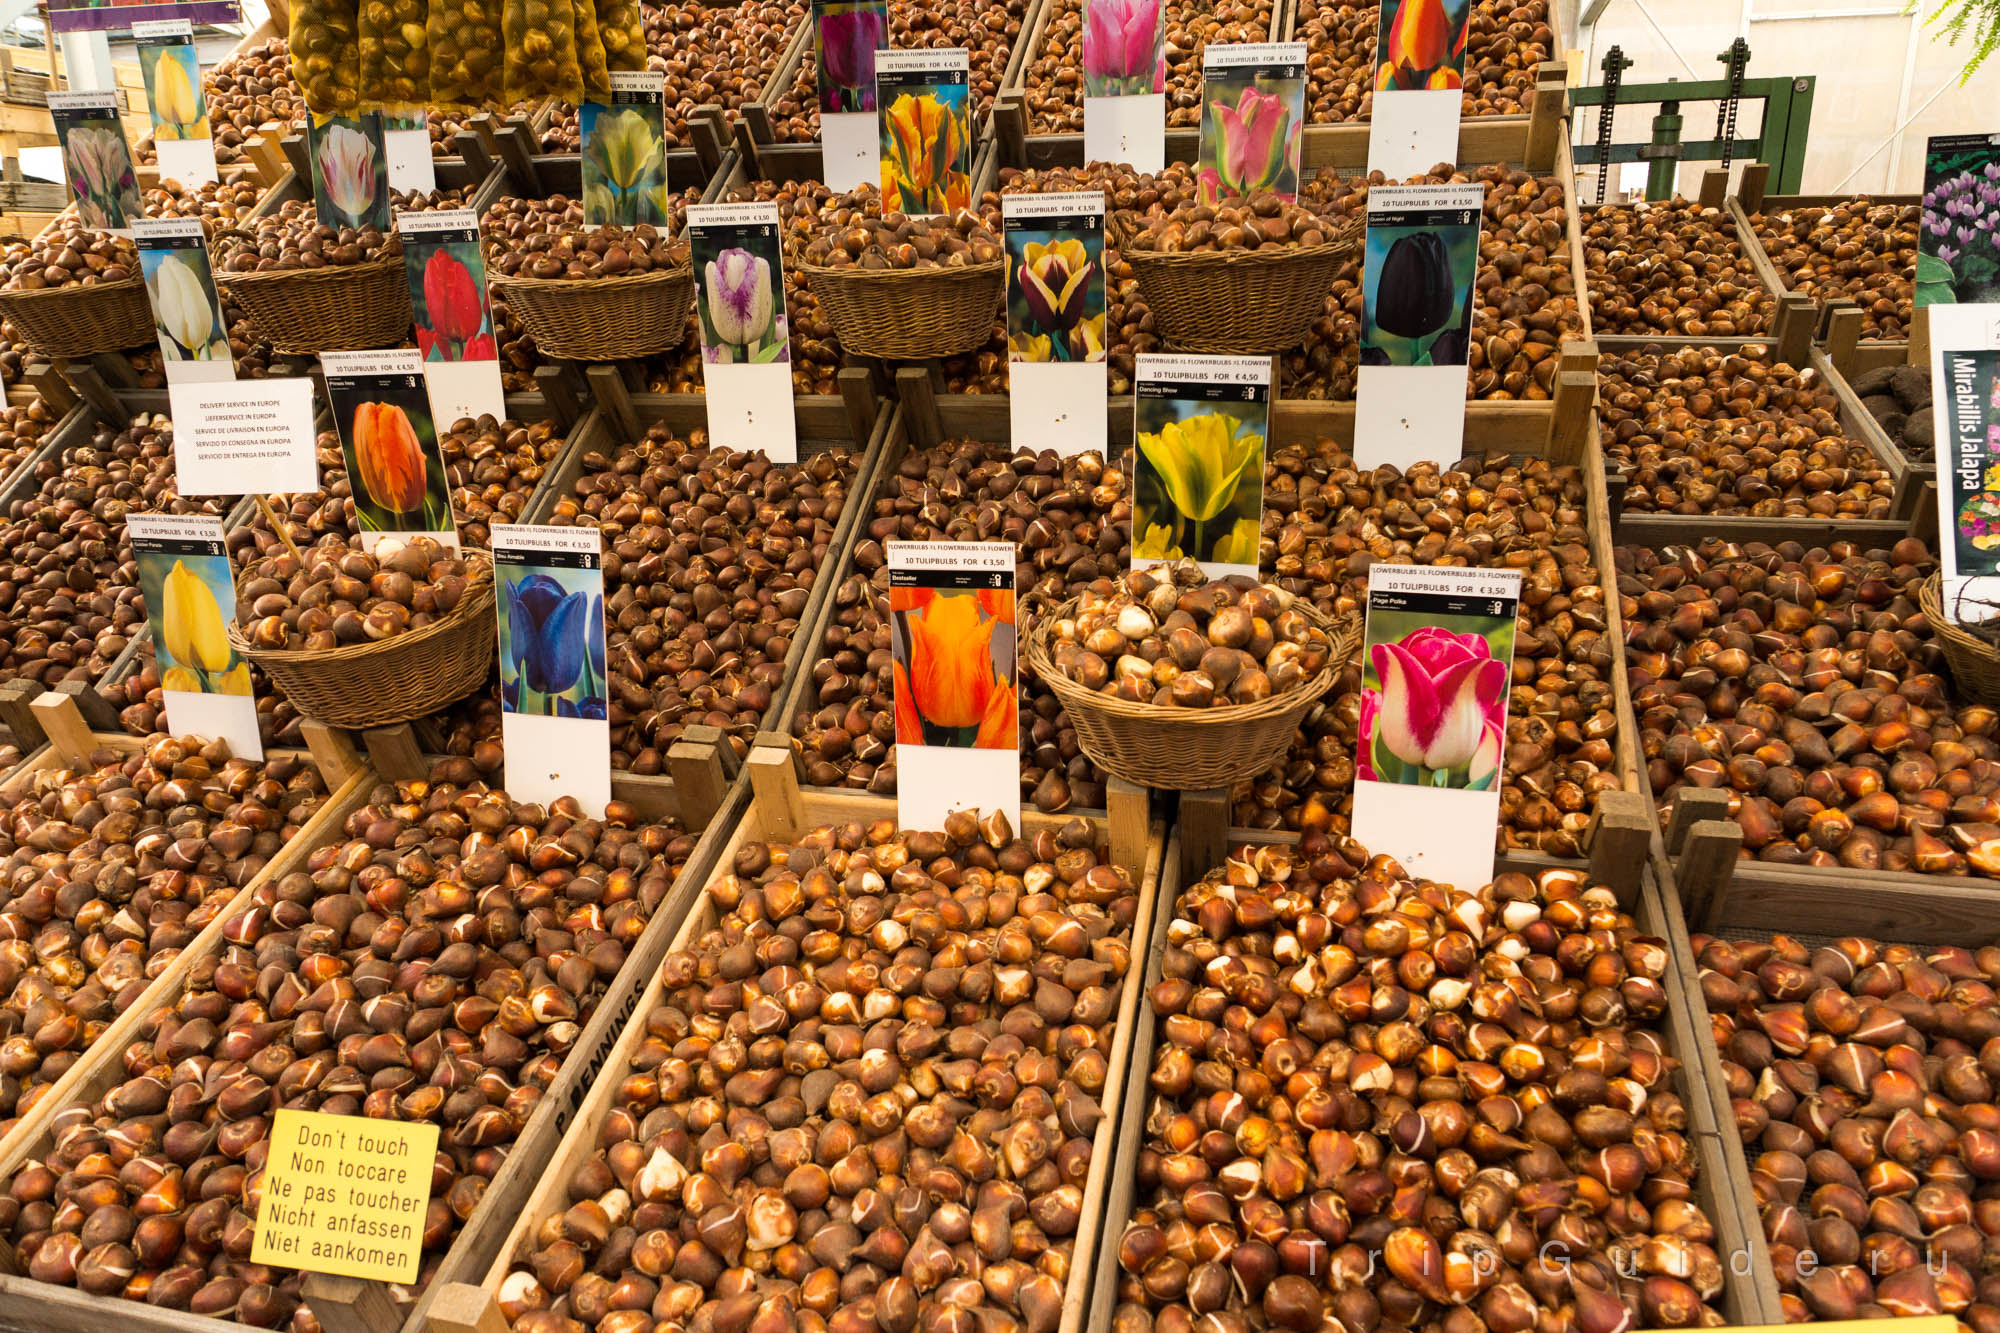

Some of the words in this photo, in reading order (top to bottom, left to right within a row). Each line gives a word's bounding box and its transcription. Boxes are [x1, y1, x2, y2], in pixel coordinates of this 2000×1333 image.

[1164, 372, 1208, 380] TULIPBULBS
[1241, 373, 1259, 381] 4,50
[1953, 358, 1981, 433] Mirabillis
[1956, 436, 1984, 490] Jalapa
[514, 539, 551, 547] TULIPBULBS
[1388, 582, 1398, 590] 10
[1400, 583, 1449, 592] TULIPBULBS
[1456, 585, 1473, 593] FOR
[1480, 586, 1486, 594] €
[1428, 570, 1477, 578] FLOWERBULBS
[298, 1125, 345, 1149] Don't
[358, 1133, 408, 1156] touch
[290, 1152, 325, 1174] Non
[338, 1159, 407, 1183] toccare
[269, 1176, 292, 1197] Ne
[304, 1185, 336, 1204] pas
[349, 1188, 420, 1213] toucher
[269, 1203, 315, 1228] Nicht
[327, 1213, 411, 1240] anfassen
[264, 1229, 299, 1253] Niet
[311, 1240, 408, 1268] aankomen
